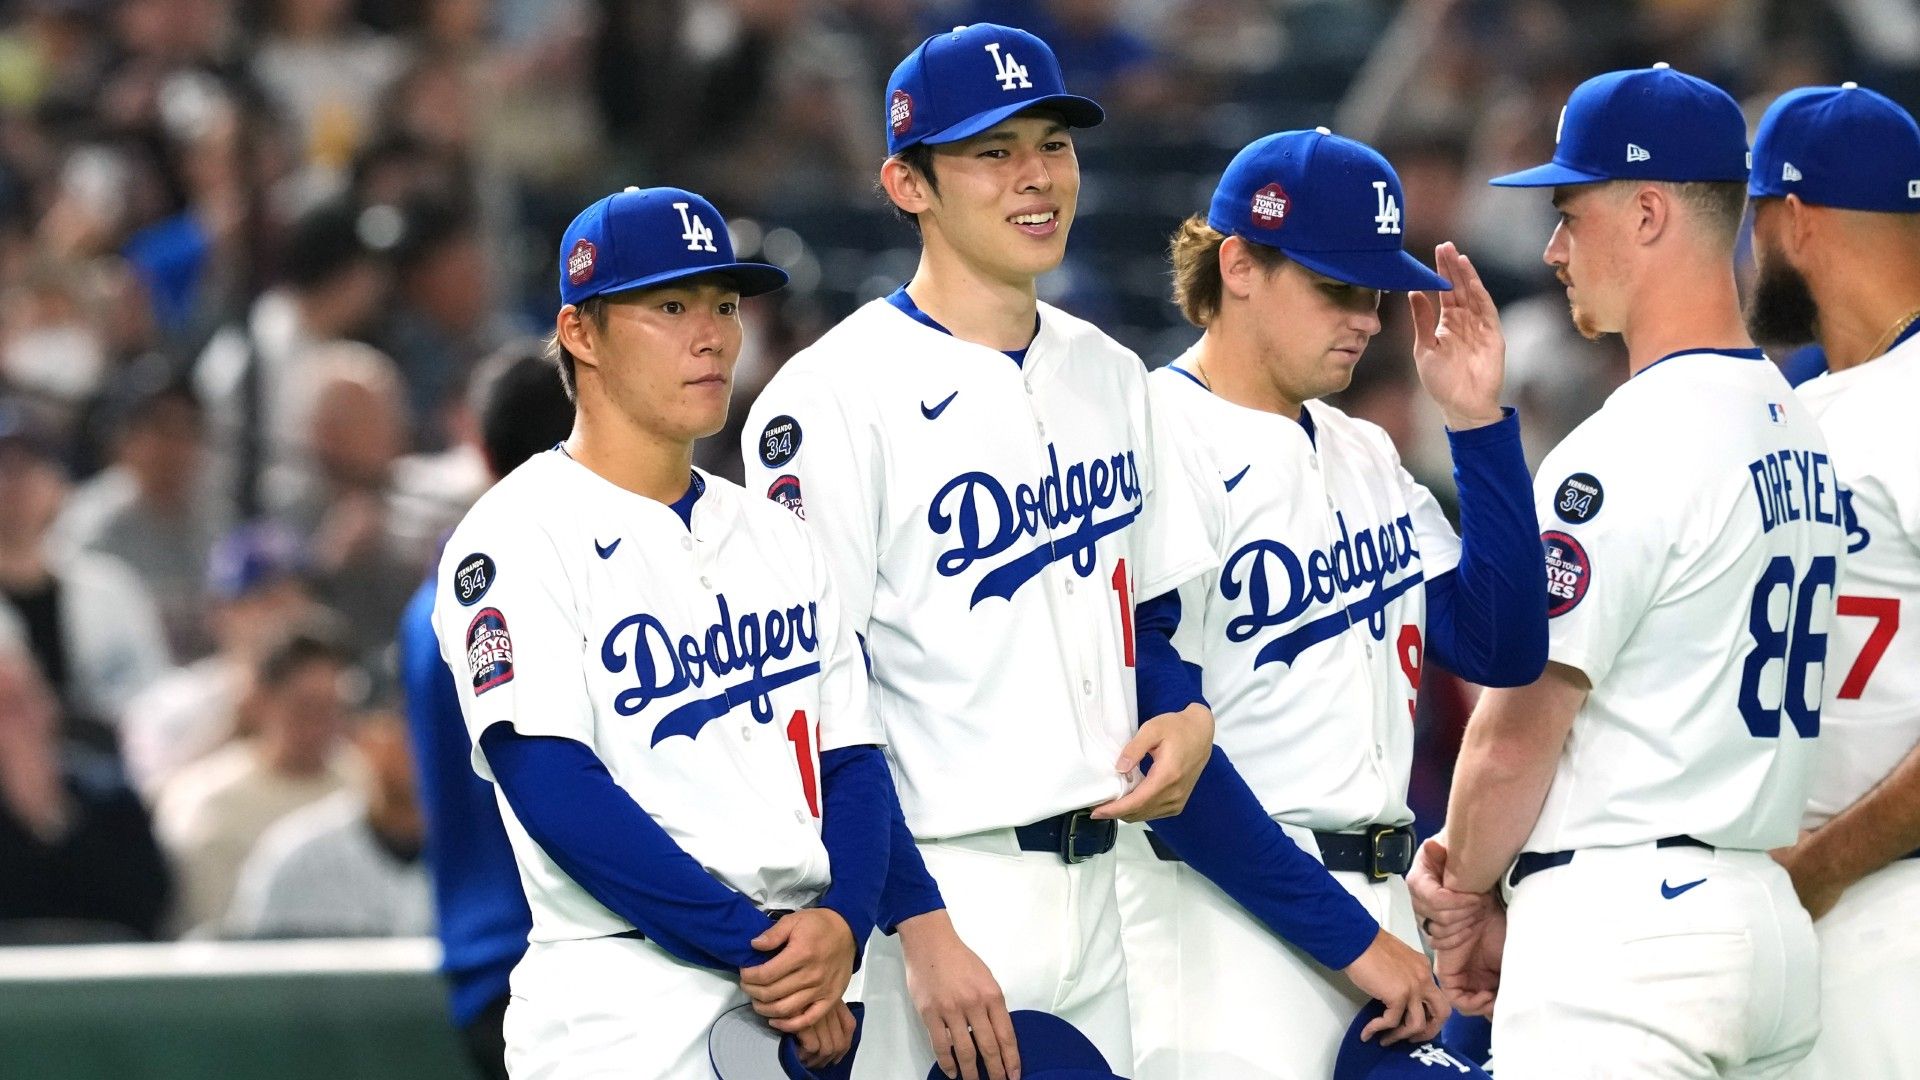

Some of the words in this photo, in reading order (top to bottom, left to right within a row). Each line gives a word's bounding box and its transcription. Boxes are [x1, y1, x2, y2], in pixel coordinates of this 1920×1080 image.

[985, 43, 1032, 91] LA
[1252, 205, 1284, 218] SERIES
[1255, 198, 1285, 211] TOKYO
[1372, 181, 1401, 234] LA
[672, 202, 718, 252] LA
[569, 252, 592, 268] TOKYO
[569, 259, 593, 276] SERIES
[765, 423, 792, 439] FERNANDO
[766, 432, 792, 461] 34
[1567, 479, 1599, 496] FERNANDO
[1748, 449, 1842, 534] DREYE
[1559, 488, 1592, 518] 34
[457, 559, 485, 580] FERNANDO
[460, 566, 486, 598] 34
[1737, 556, 1836, 738] 86
